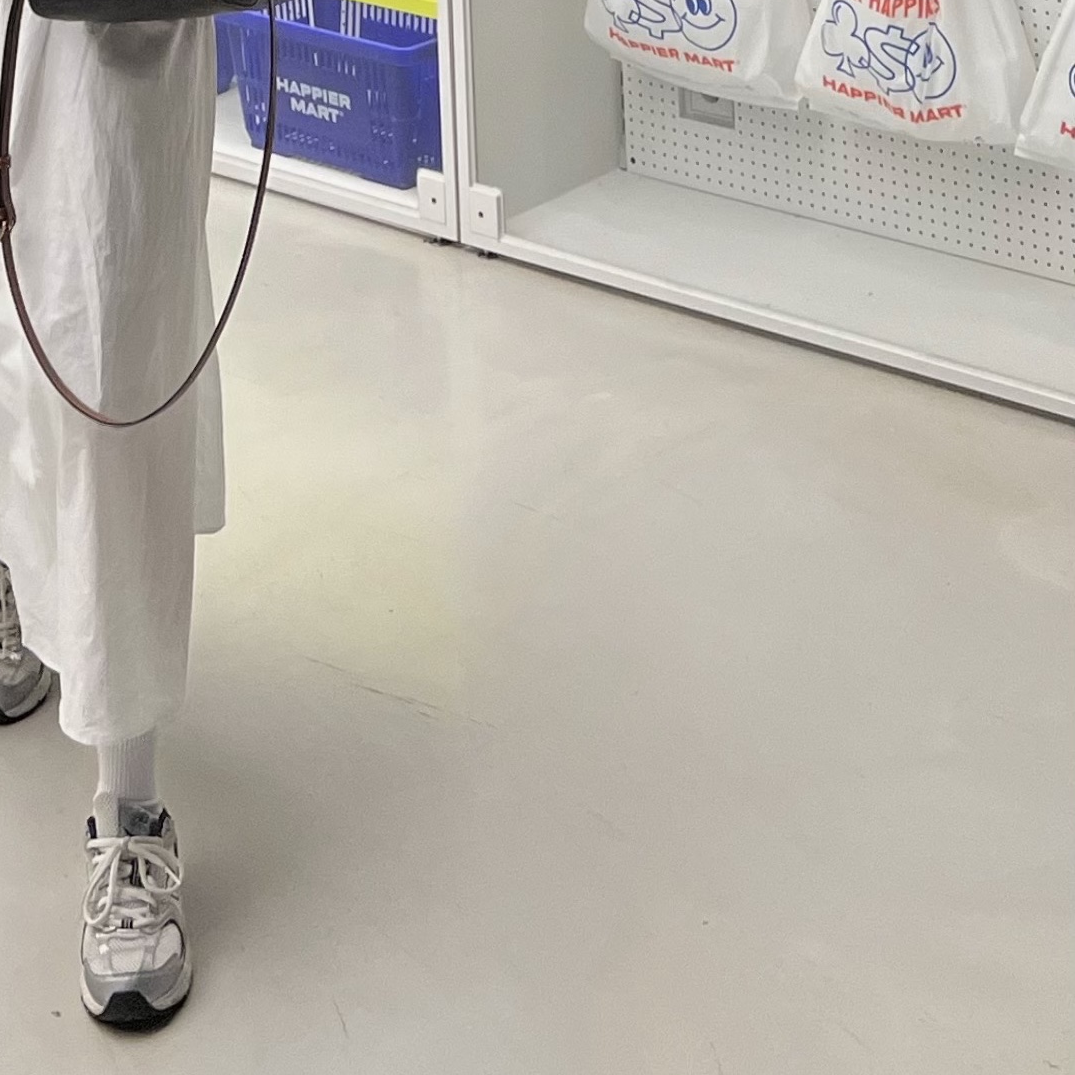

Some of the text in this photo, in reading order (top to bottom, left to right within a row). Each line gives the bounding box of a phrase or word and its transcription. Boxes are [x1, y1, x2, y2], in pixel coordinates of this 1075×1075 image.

[683, 52, 735, 73] MART
[277, 77, 352, 110] HAPPIER
[290, 97, 341, 123] MART
